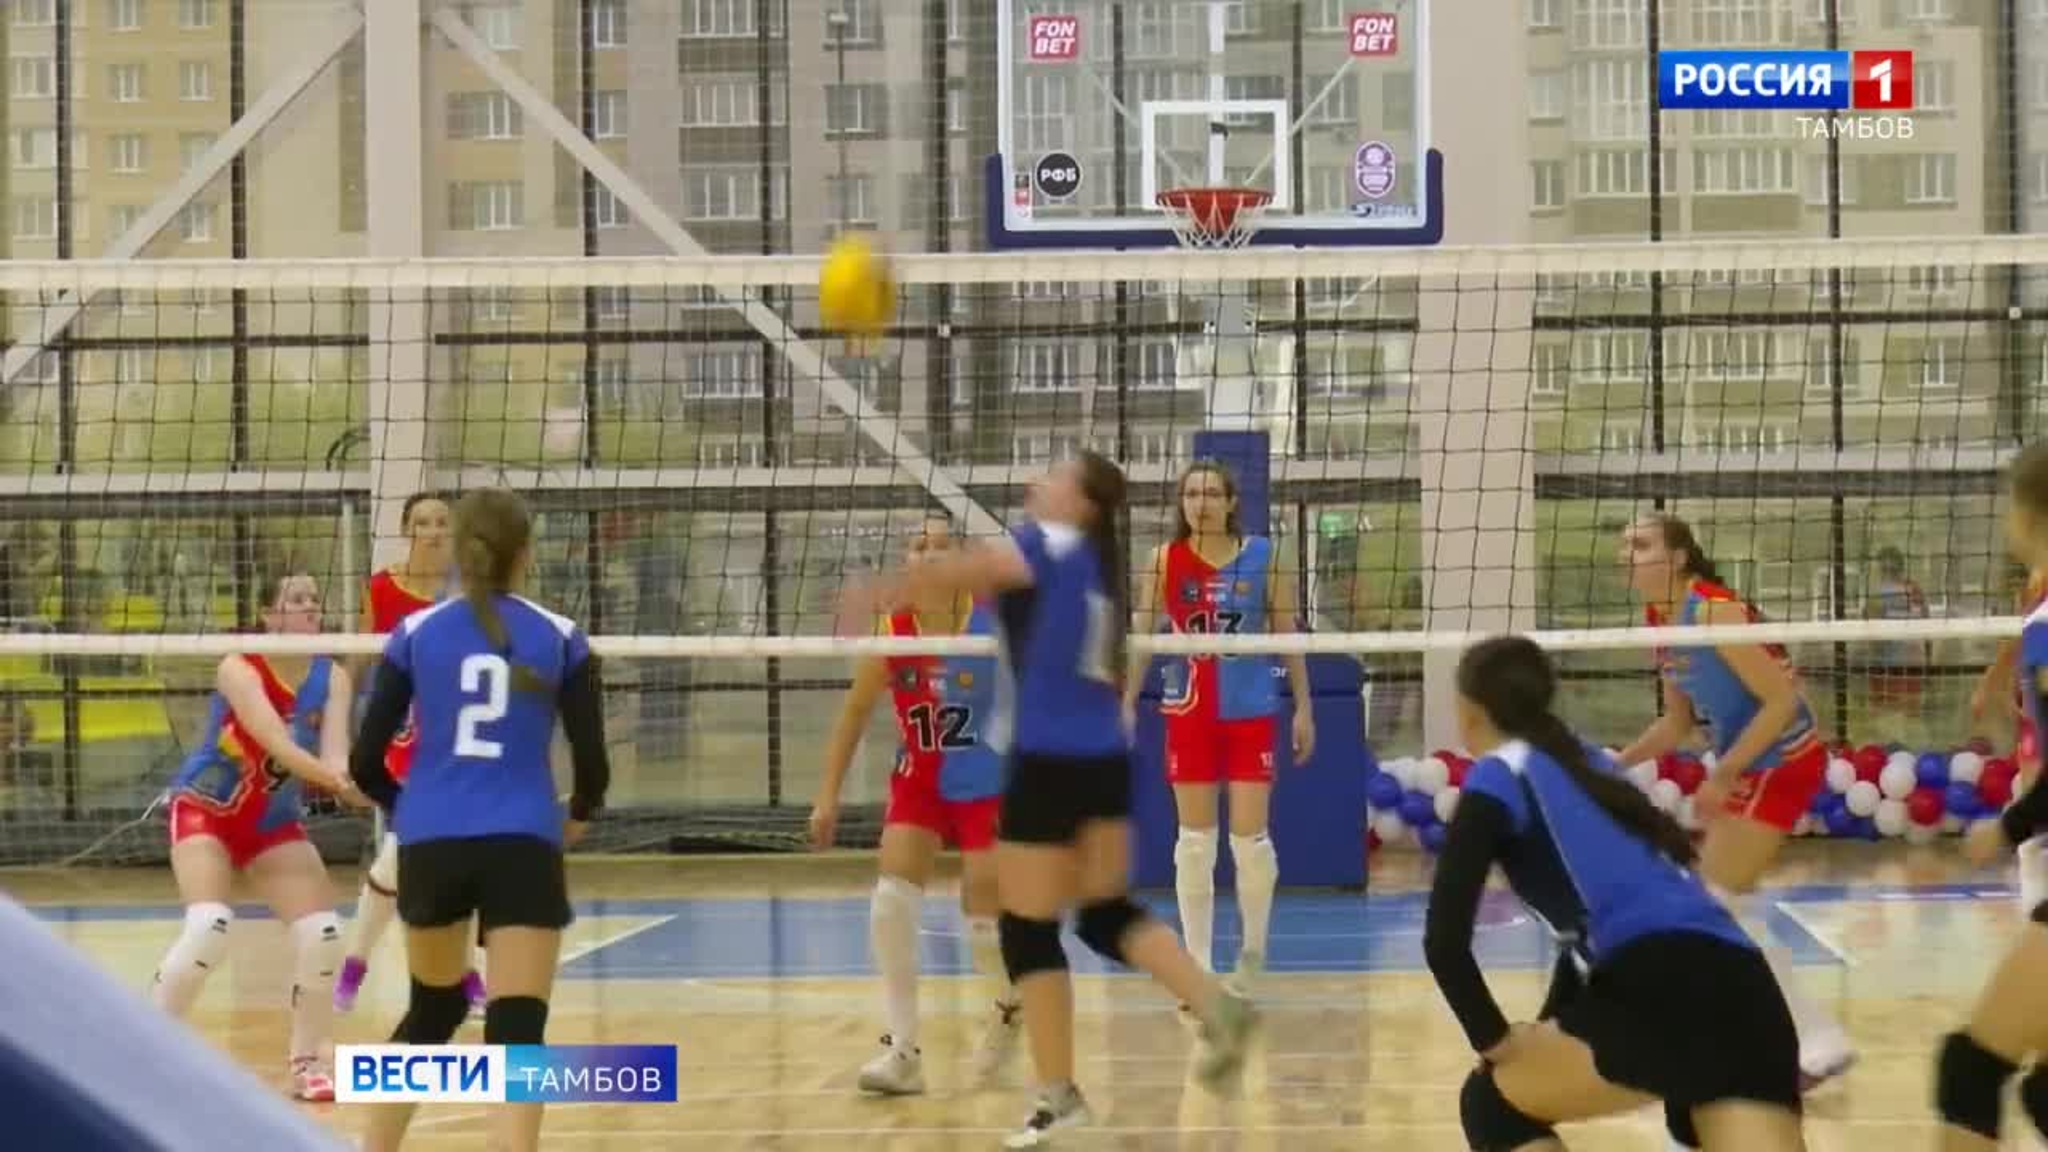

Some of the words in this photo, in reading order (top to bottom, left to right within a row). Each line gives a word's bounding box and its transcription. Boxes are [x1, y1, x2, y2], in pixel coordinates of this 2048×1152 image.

[1034, 20, 1076, 37] FON
[1352, 17, 1395, 34] FON
[1034, 37, 1076, 55] BET
[1352, 34, 1395, 52] BET
[1040, 167, 1077, 182] РФБ
[453, 652, 510, 759] 2
[908, 702, 976, 752] 12
